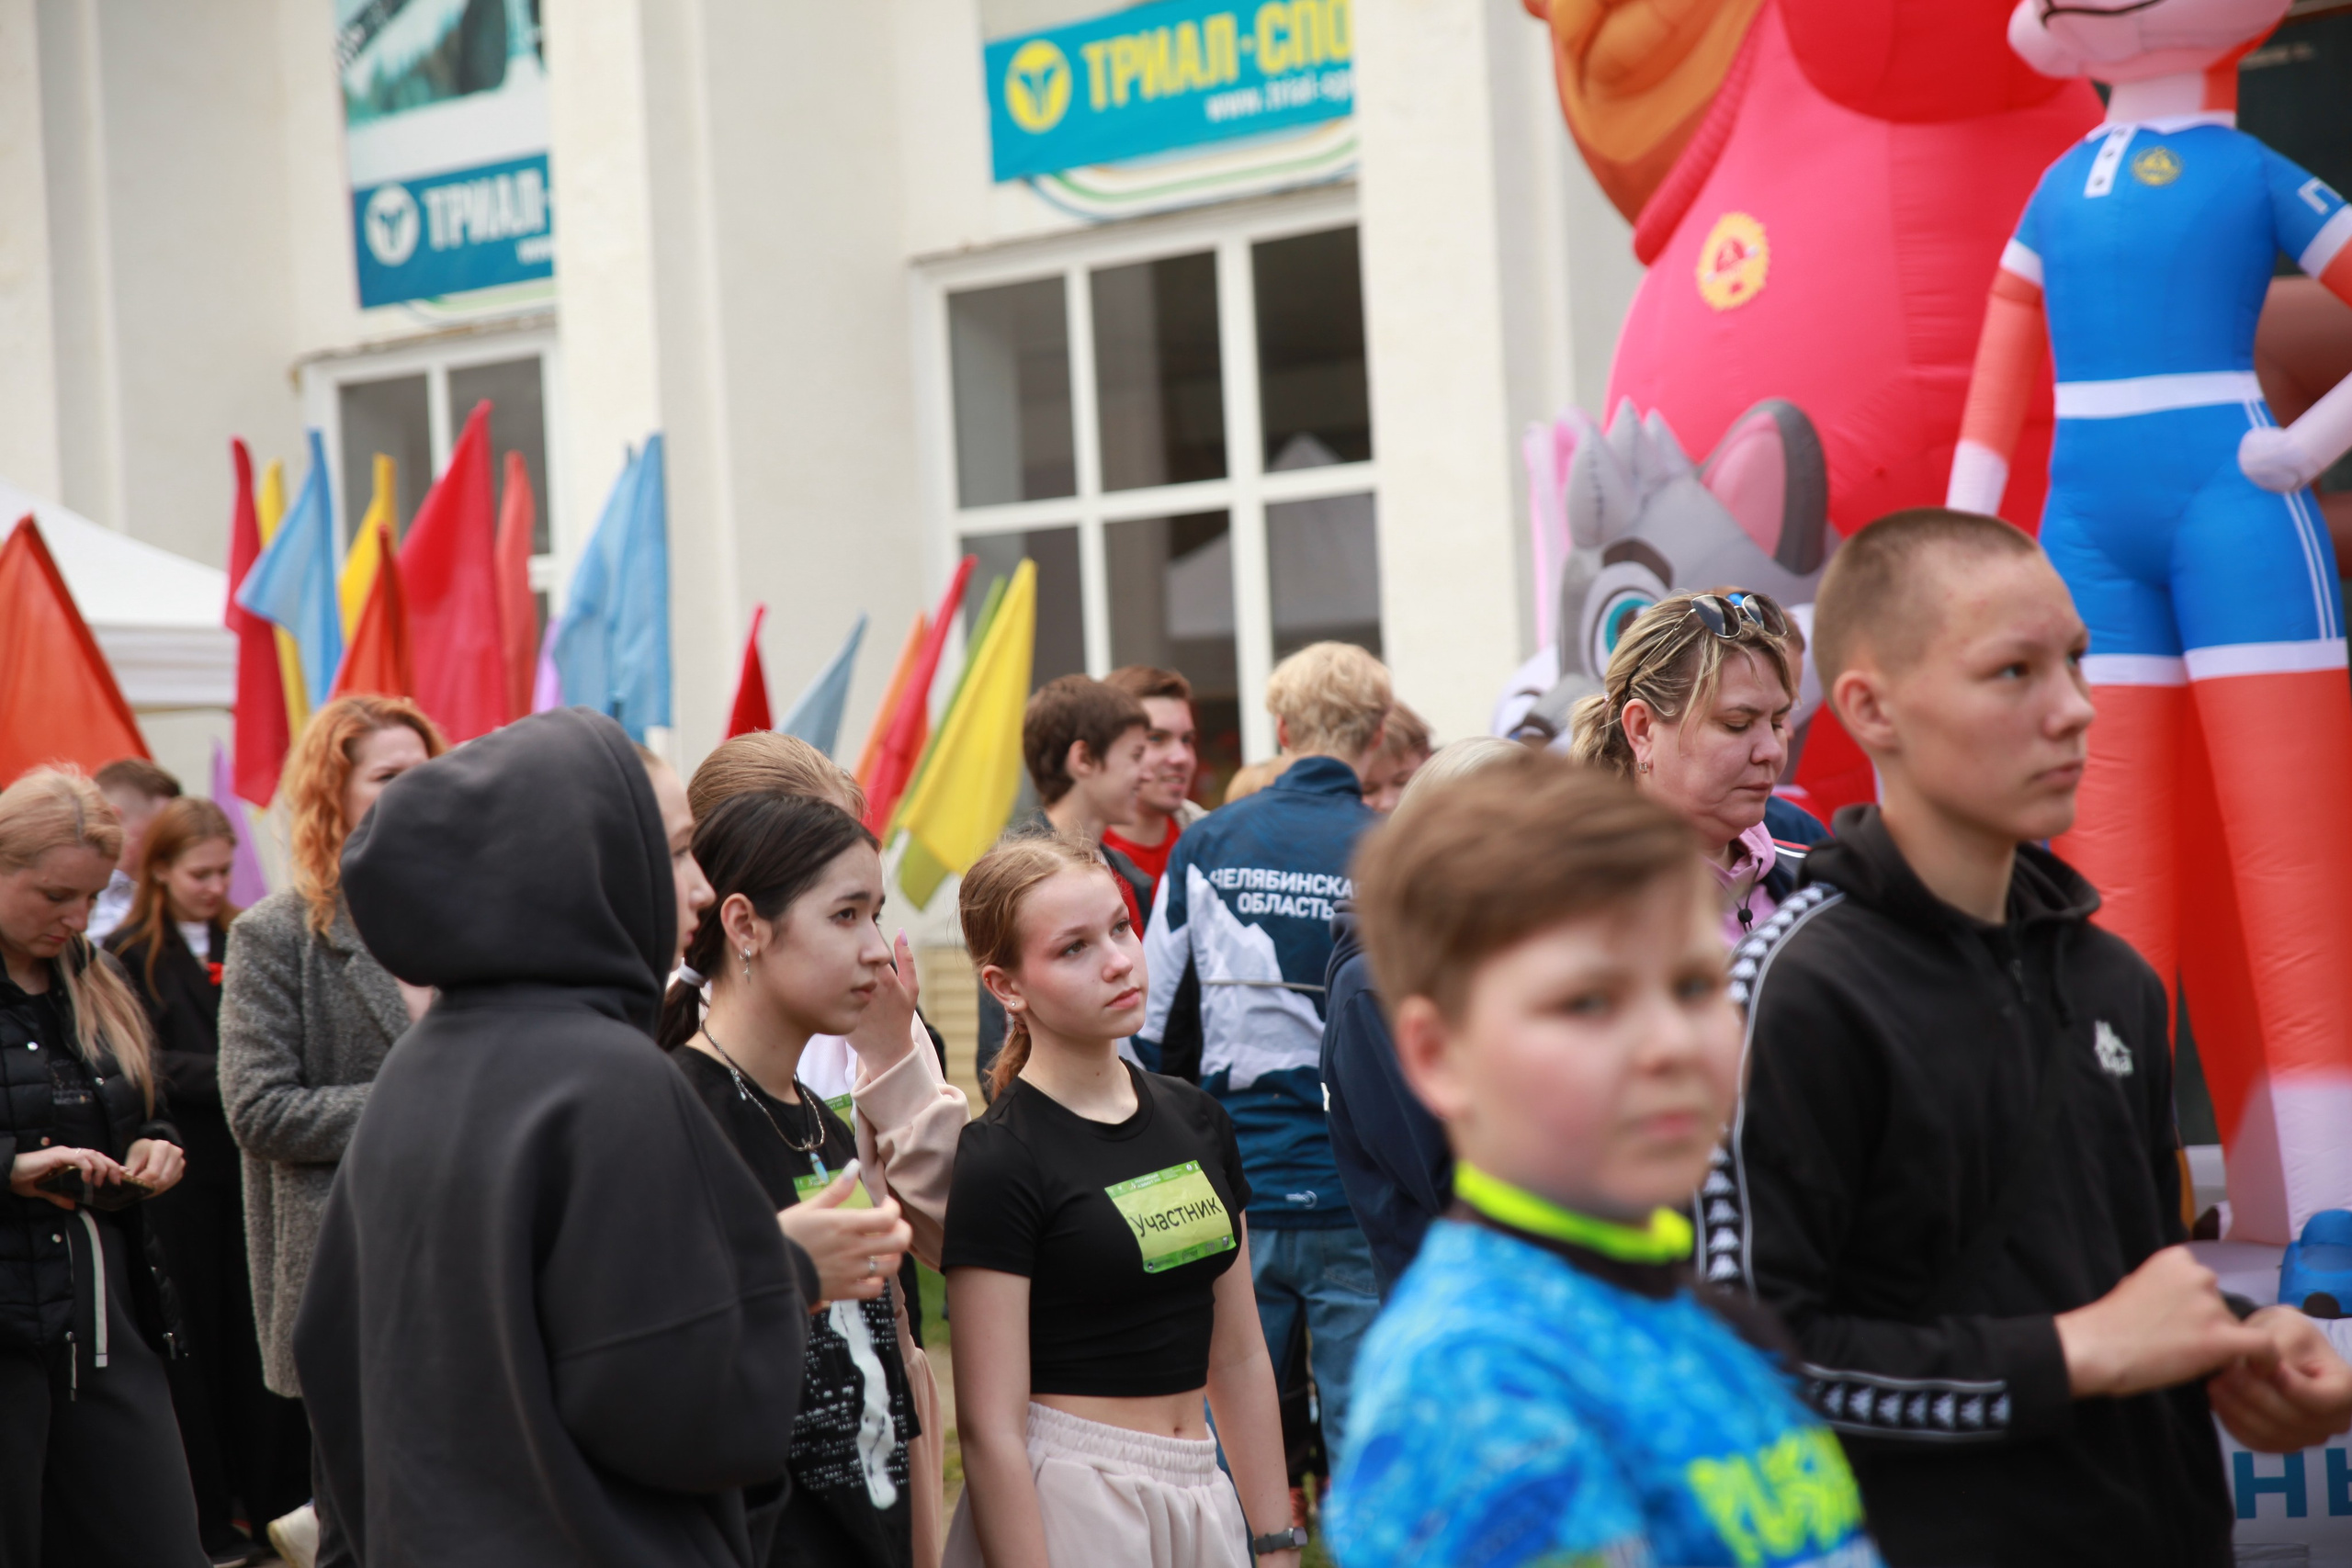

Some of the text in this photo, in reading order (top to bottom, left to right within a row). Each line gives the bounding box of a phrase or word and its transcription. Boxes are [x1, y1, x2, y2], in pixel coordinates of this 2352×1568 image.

[1209, 868, 1361, 900] ЧЕЛЯБИНСКА
[1238, 892, 1336, 921] ОБЛАСТЬ
[1129, 1197, 1223, 1237] Участник
